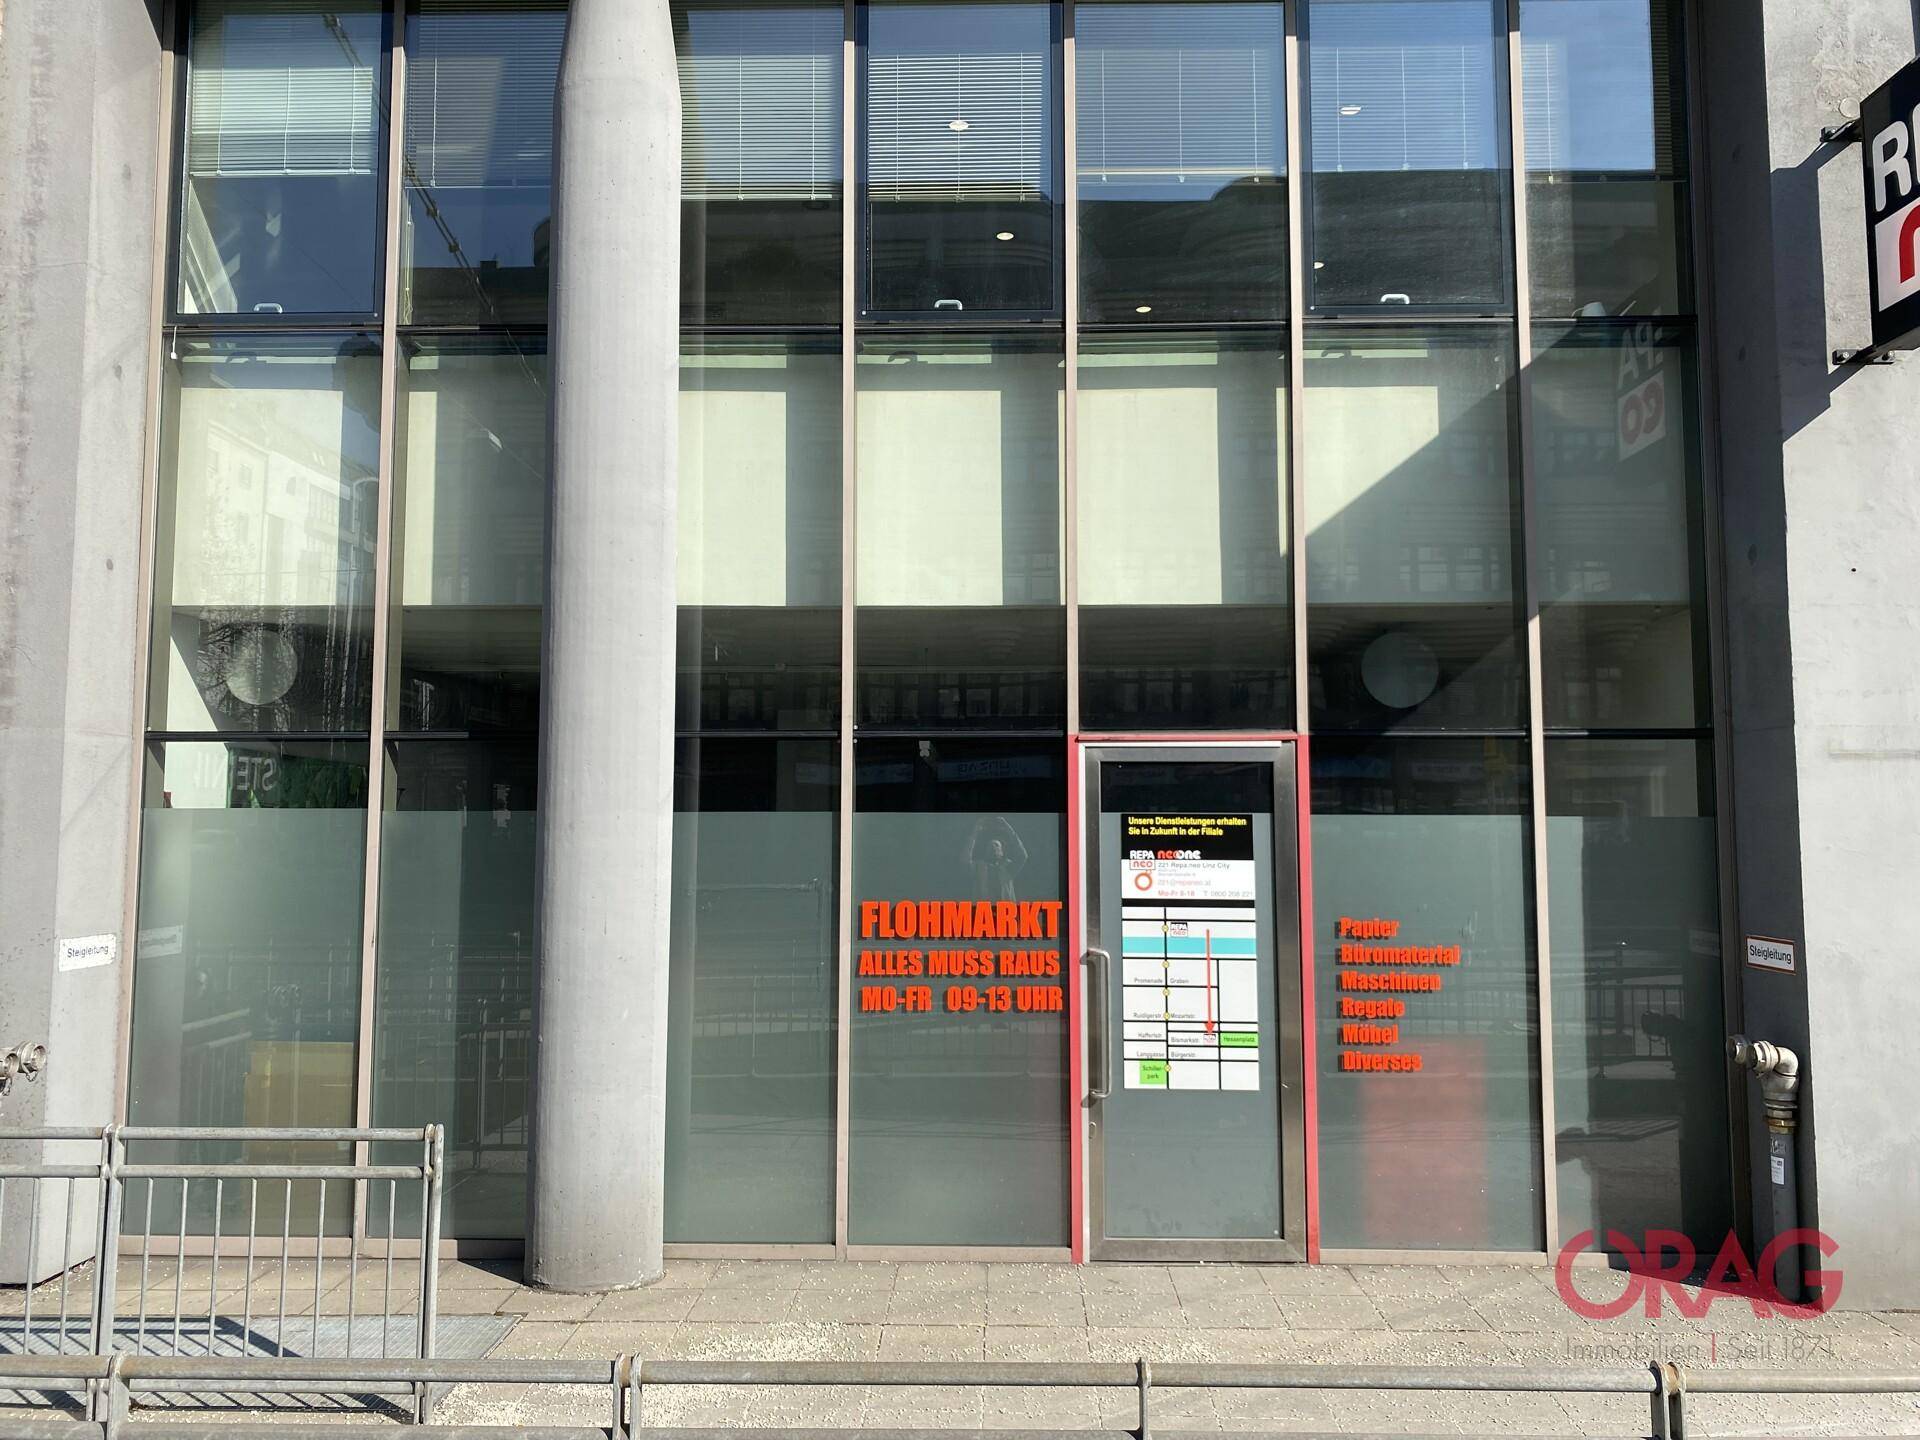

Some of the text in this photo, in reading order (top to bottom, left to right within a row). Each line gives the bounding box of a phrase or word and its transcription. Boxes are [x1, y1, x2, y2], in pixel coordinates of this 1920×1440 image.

[1872, 103, 1920, 212] R
[1128, 817, 1247, 827] Unsere Dienstleistungen erhalten
[1128, 827, 1224, 836] Sie in Zukunft in der Filiale
[1129, 850, 1155, 859] REPA
[861, 901, 1063, 938] FLOHMARKT
[1339, 916, 1399, 938] Papier
[67, 945, 109, 958] Steigleitung
[1340, 943, 1461, 965] Büromaterial
[1749, 944, 1792, 965] Steigleitung
[859, 950, 1060, 976] ALLES MUSS RAUS
[1341, 970, 1441, 990] Maschinen
[861, 986, 1063, 1012] MO-FR 09-13 UHR
[1342, 997, 1405, 1019] Regale
[1342, 1023, 1399, 1044] Möbel
[1343, 1050, 1423, 1071] Diverses
